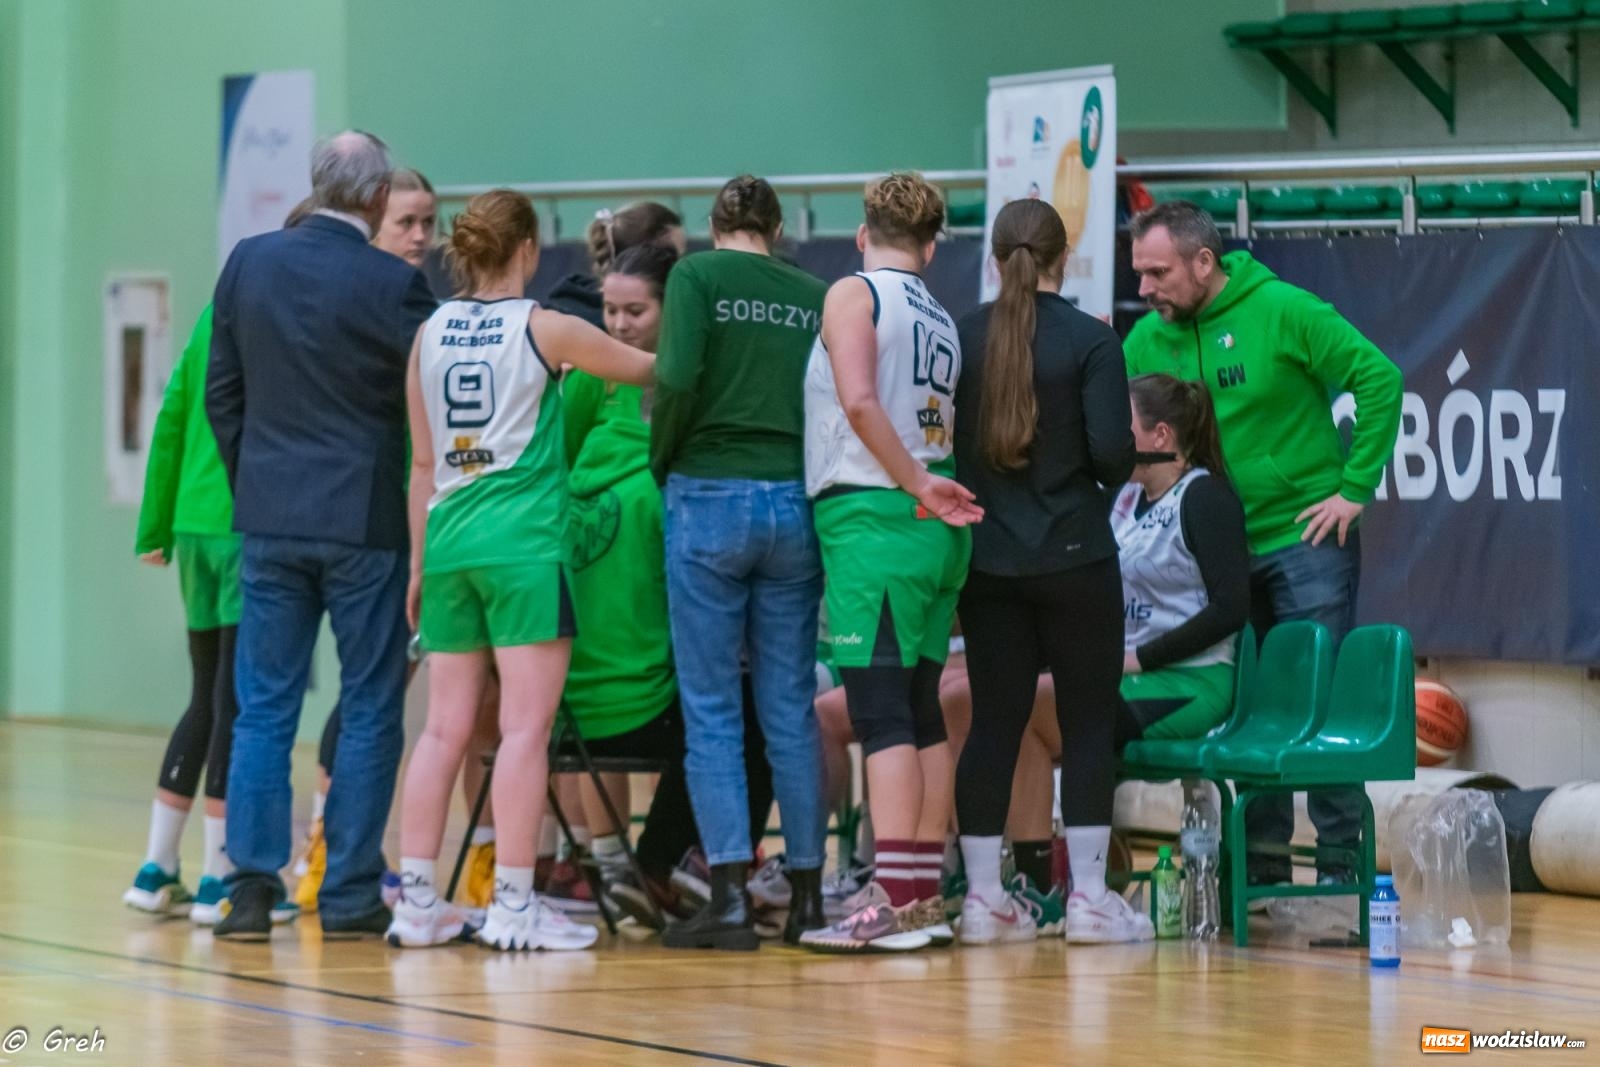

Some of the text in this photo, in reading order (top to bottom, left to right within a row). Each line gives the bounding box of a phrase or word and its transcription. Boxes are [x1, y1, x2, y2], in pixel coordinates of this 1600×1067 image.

[440, 333, 503, 347] RACBÓRZ
[444, 361, 495, 428] 9
[1331, 349, 1567, 502] BÓRZ
